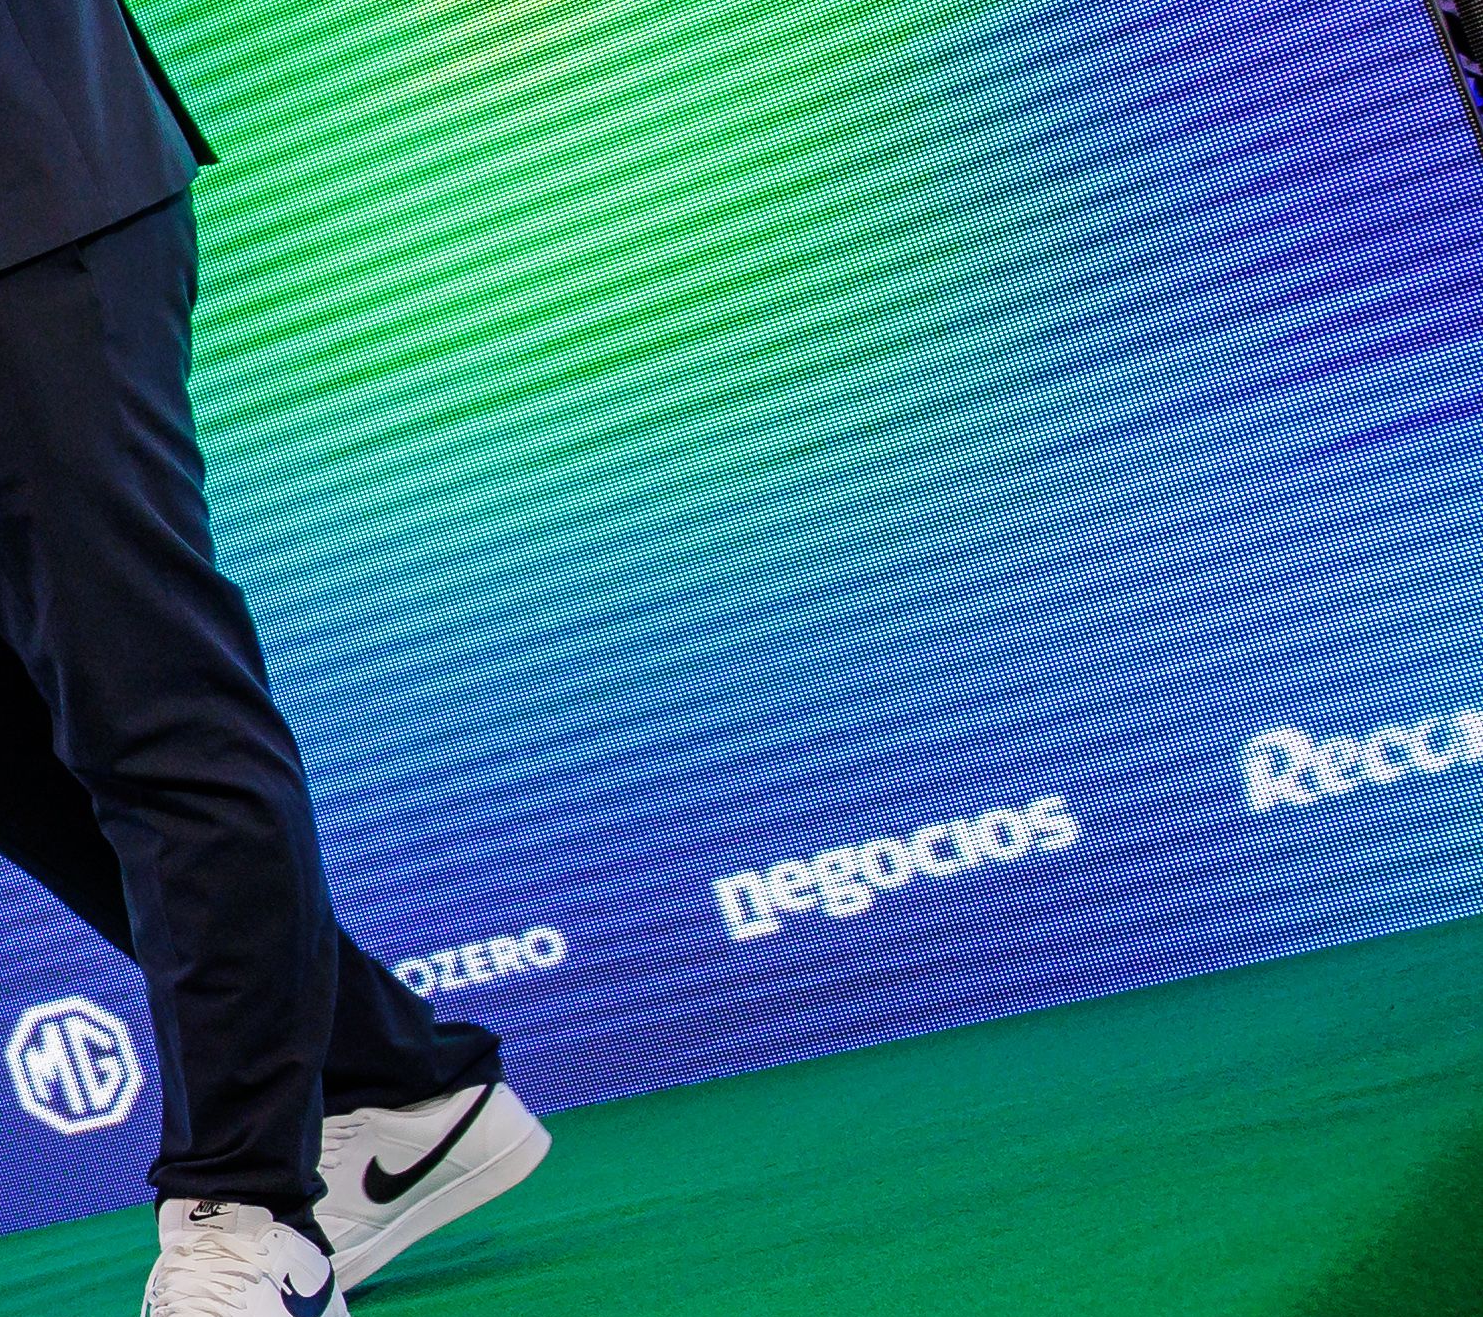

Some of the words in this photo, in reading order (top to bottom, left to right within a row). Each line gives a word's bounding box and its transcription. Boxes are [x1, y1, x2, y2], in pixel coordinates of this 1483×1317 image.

[714, 791, 1081, 942] negocios
[391, 925, 568, 997] OZERO
[23, 1012, 131, 1120] MG
